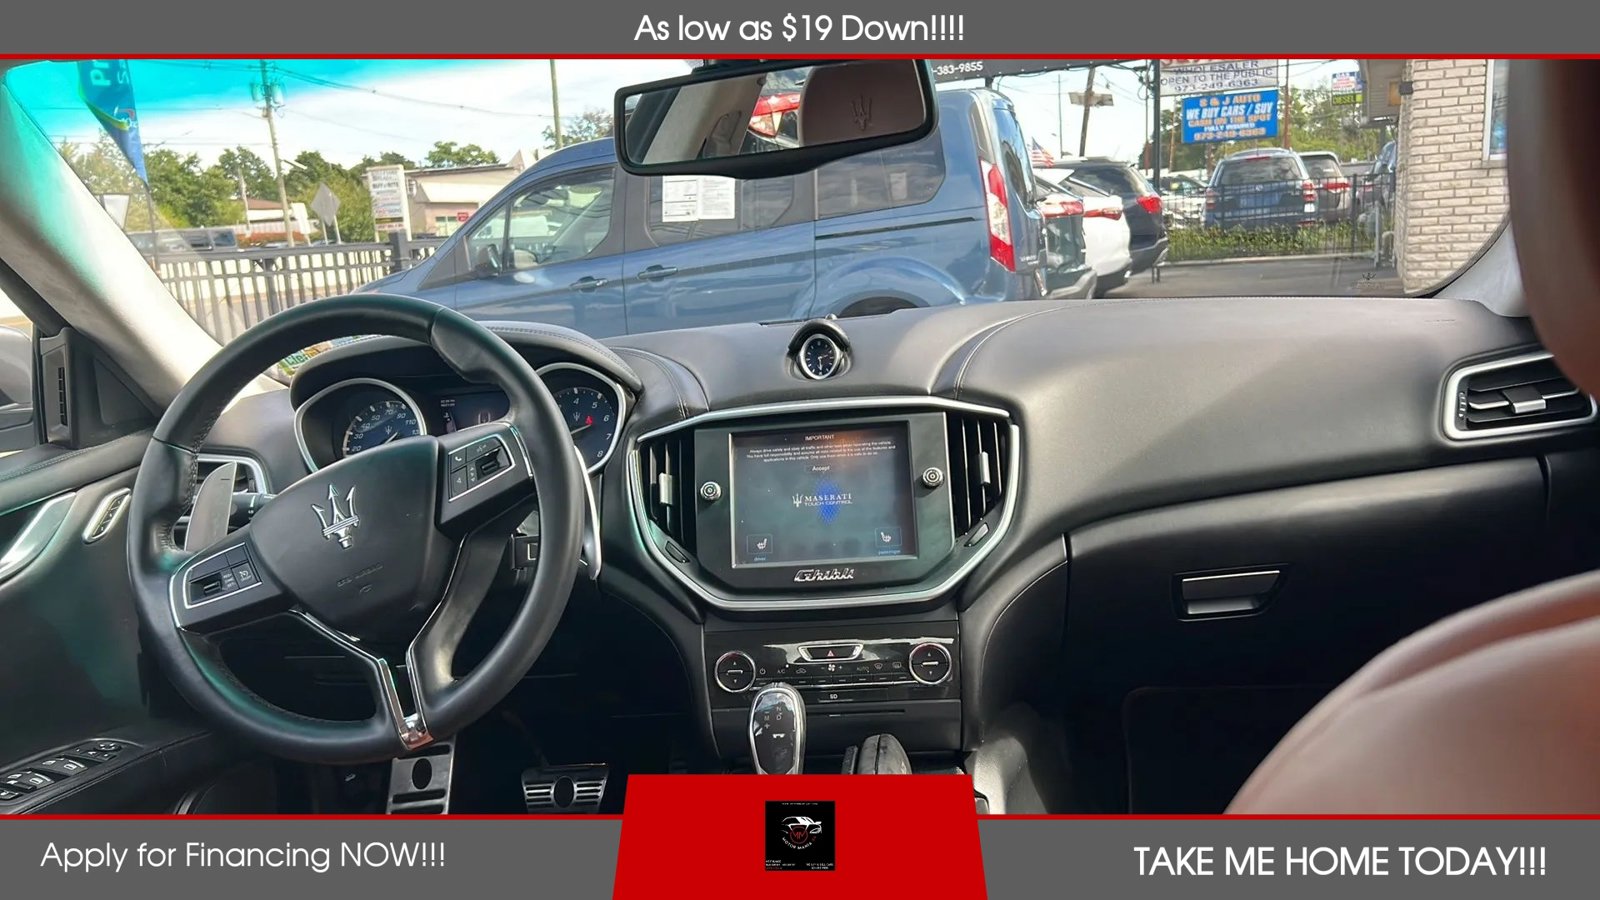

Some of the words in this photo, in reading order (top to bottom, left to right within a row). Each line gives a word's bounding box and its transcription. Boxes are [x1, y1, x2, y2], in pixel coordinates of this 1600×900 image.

[1160, 75, 1190, 86] OPEN
[1193, 74, 1206, 83] TO
[1210, 71, 1231, 81] THE
[1233, 67, 1273, 79] PUBLIC
[1186, 108, 1200, 120] WE
[1201, 106, 1220, 119] BUY
[1221, 104, 1246, 116] CARS
[573, 397, 580, 405] 4
[592, 401, 598, 409] 5
[396, 412, 406, 420] 90
[603, 414, 610, 422] 6
[804, 434, 835, 442] IMPORTANT
[597, 450, 604, 458] 8
[804, 493, 852, 502] MASERATI
[793, 567, 855, 583] Ghibli
